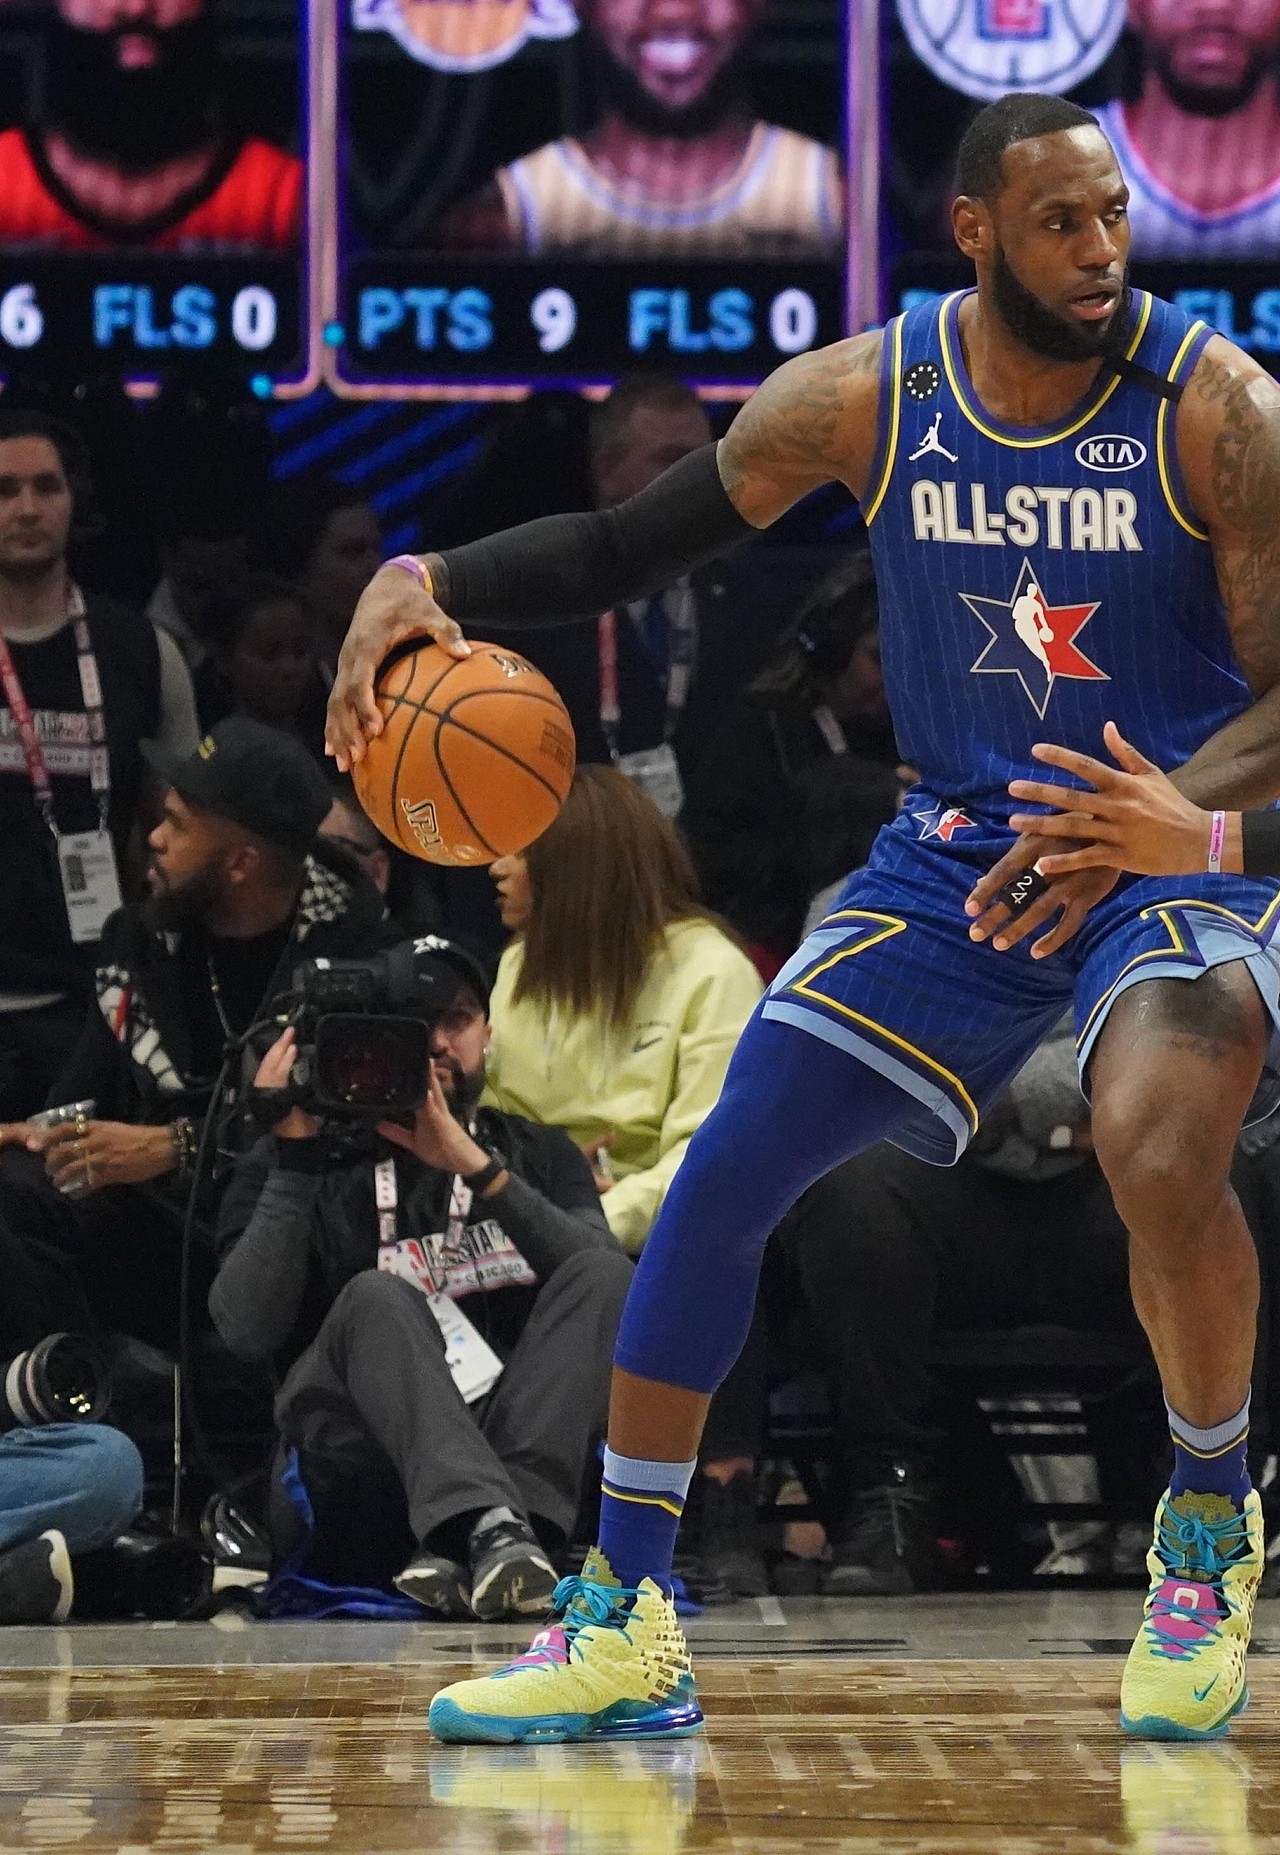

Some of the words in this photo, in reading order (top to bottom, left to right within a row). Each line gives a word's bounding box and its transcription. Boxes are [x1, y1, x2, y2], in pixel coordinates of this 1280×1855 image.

[0, 283, 44, 348] 6
[93, 283, 218, 349] FLS
[231, 283, 277, 350] 0
[358, 287, 494, 351] PTS
[530, 287, 577, 353] 9
[628, 288, 756, 352] FLS
[768, 287, 817, 354] 0
[1088, 443, 1135, 464] KIA
[911, 479, 1144, 552] ALL-STAR
